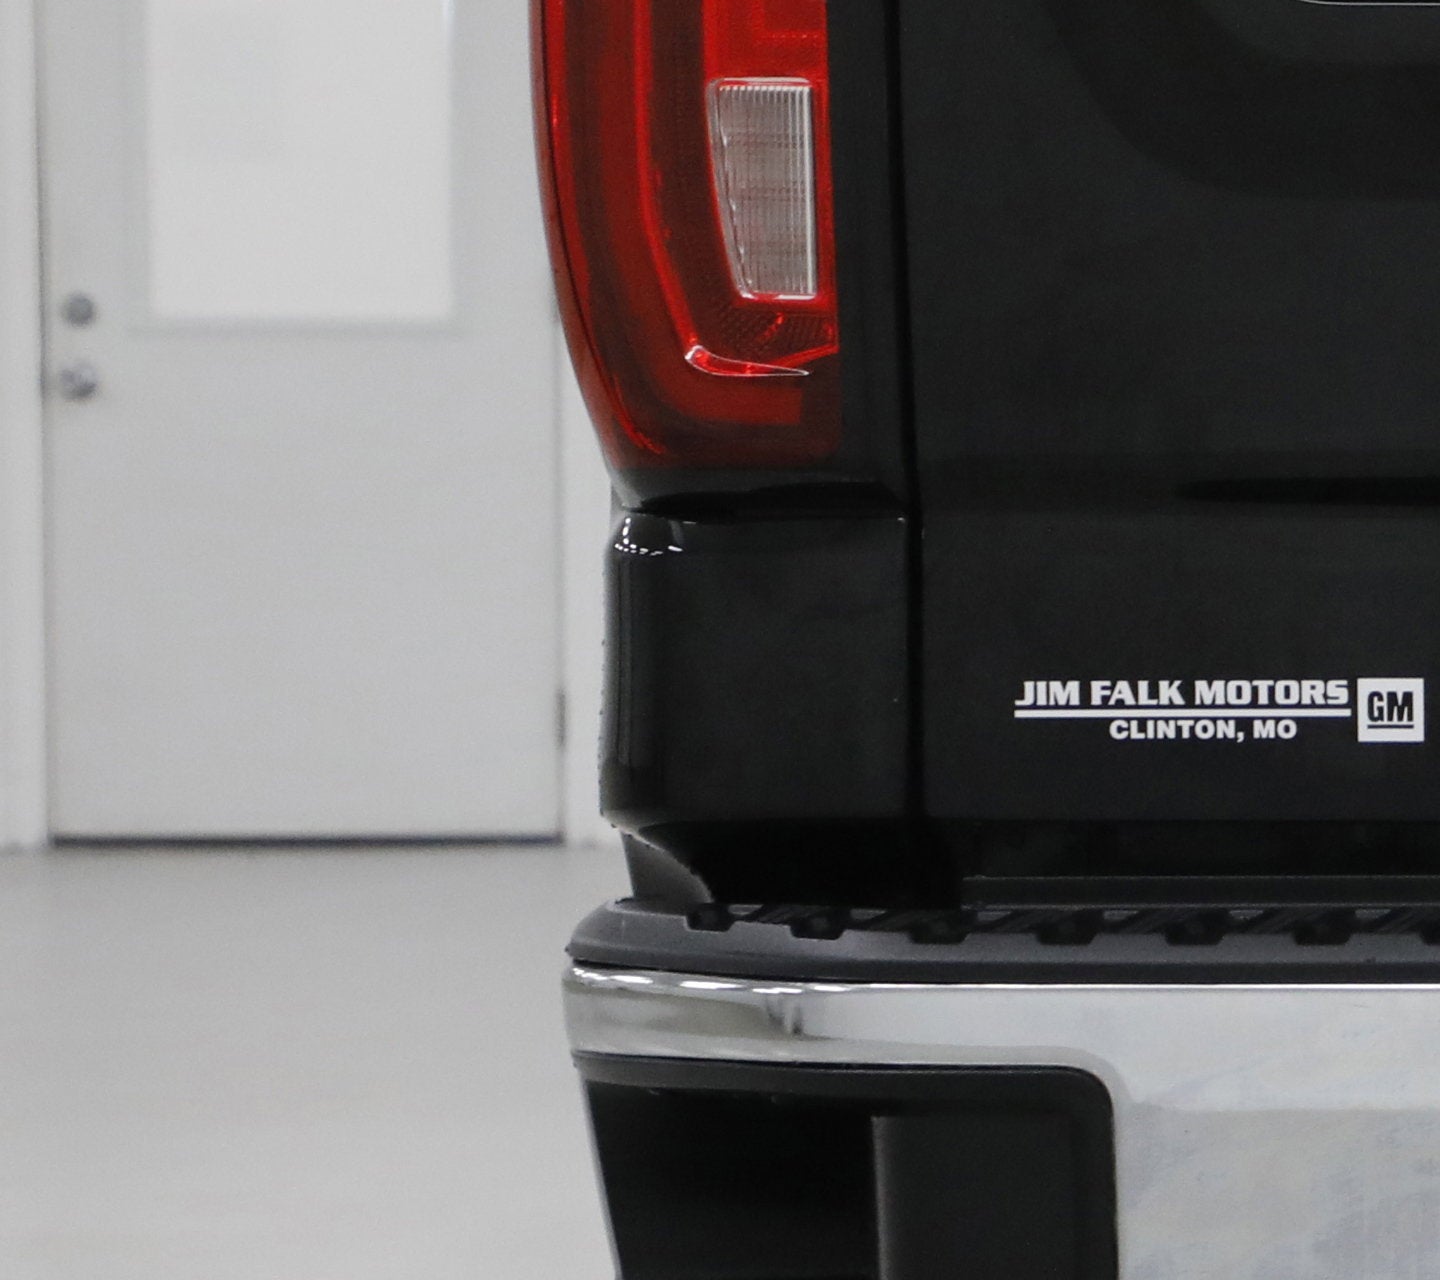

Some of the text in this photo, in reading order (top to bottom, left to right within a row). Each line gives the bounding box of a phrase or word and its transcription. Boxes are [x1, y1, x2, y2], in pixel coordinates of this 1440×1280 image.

[1014, 679, 1350, 707] JIM FALK MOTORS
[1366, 690, 1415, 723] GM
[1109, 718, 1298, 743] CLINTON, MO
